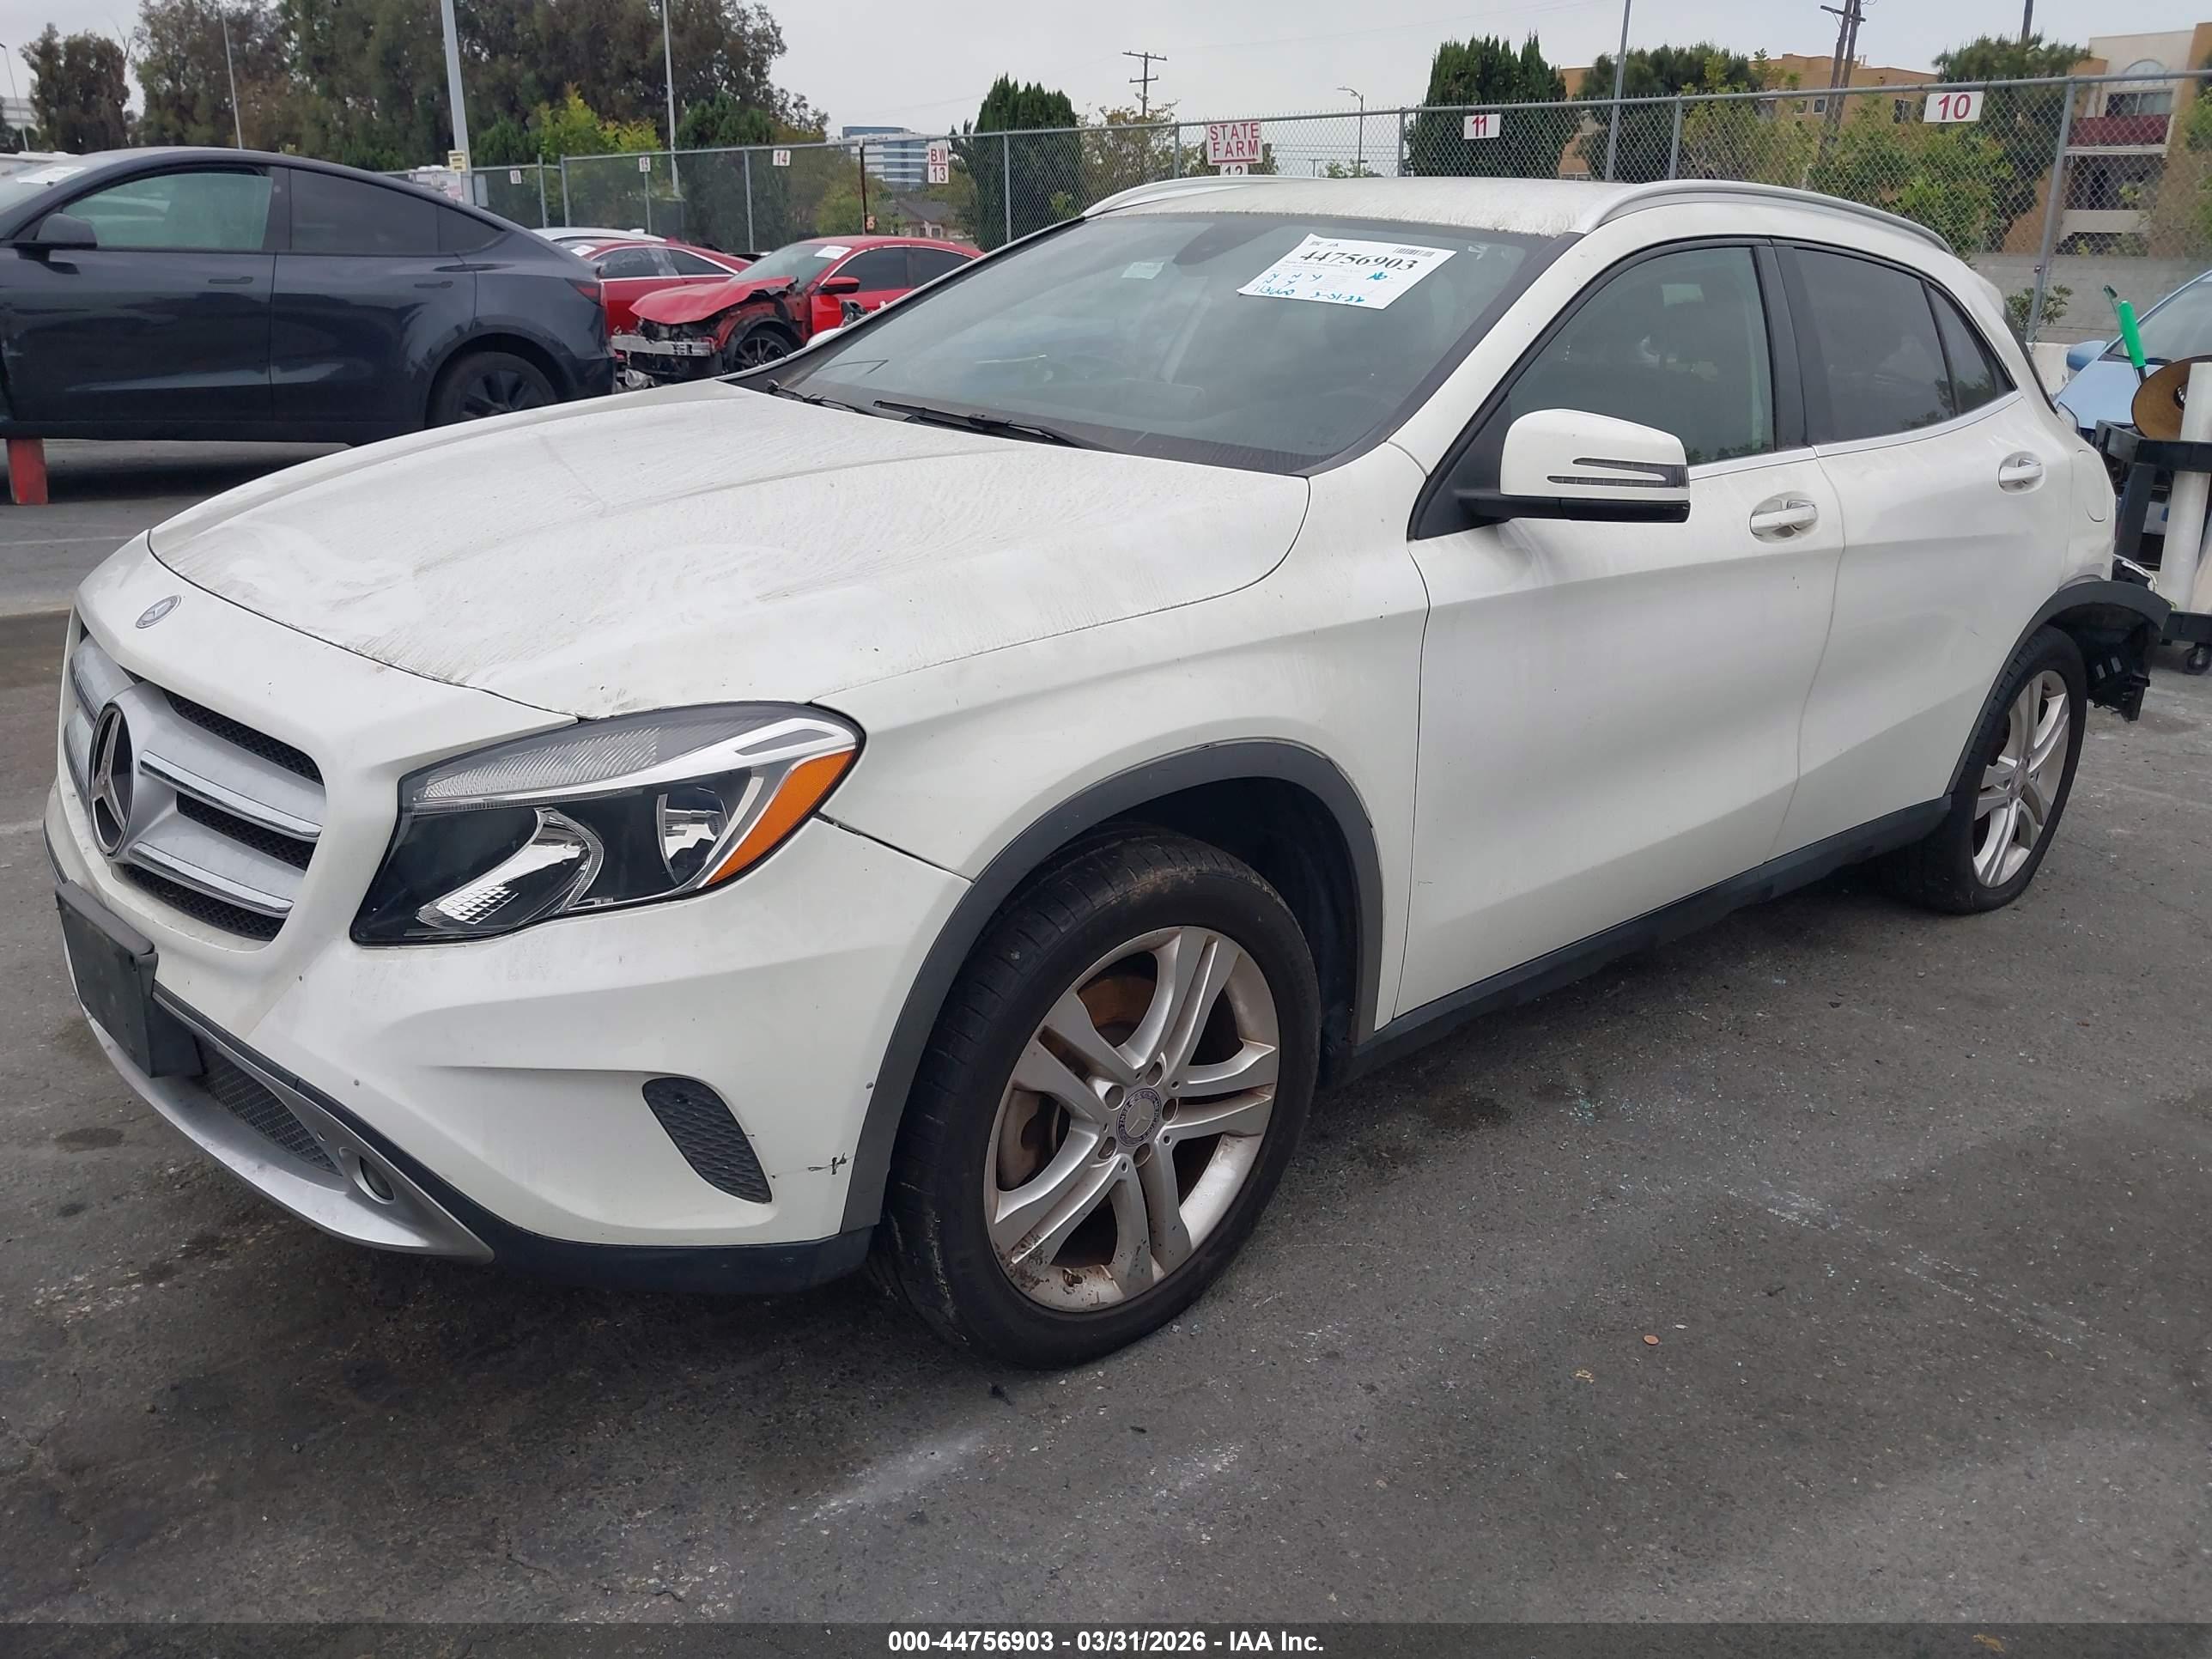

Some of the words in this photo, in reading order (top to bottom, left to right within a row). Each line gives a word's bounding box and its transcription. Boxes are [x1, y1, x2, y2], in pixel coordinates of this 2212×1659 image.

[1937, 94, 1972, 120] 10
[1210, 123, 1260, 141] STATE
[1472, 116, 1487, 137] 11
[931, 148, 946, 162] BW
[1212, 140, 1259, 158] FARM
[776, 151, 788, 166] 14
[933, 167, 946, 182] 13
[1300, 250, 1419, 270] 44756903
